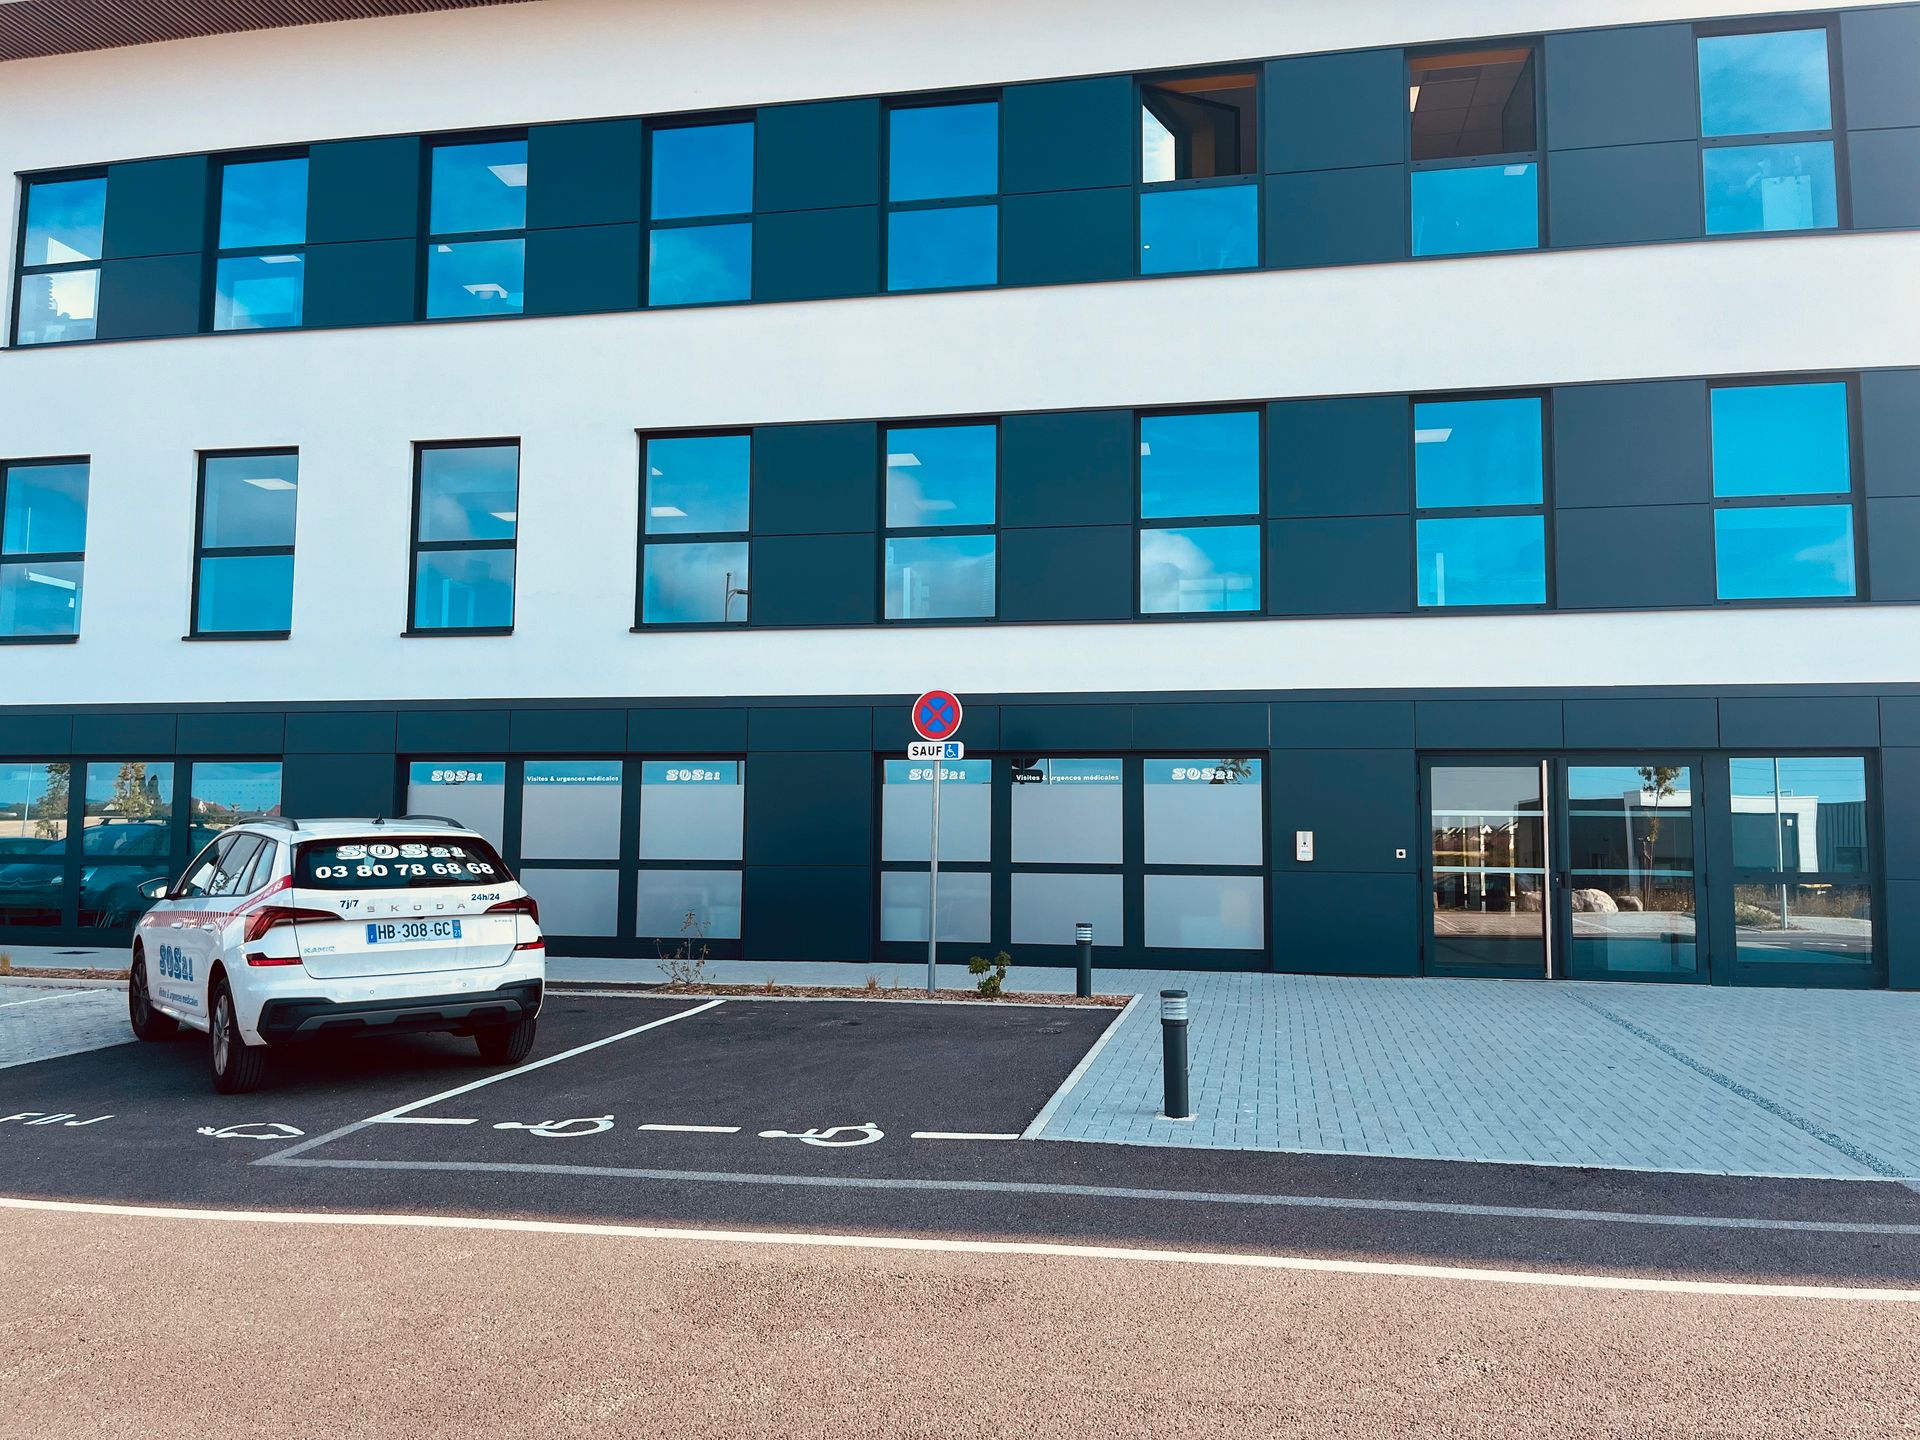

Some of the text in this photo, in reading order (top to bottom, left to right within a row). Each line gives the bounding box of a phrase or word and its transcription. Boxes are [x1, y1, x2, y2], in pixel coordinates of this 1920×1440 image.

[912, 746, 942, 756] SAUF
[315, 862, 495, 879] 03 80 78 68 68
[471, 893, 500, 901] 24h/24
[339, 899, 360, 910] 7j/7
[377, 922, 451, 940] HB-308-GC
[454, 929, 462, 937] 21
